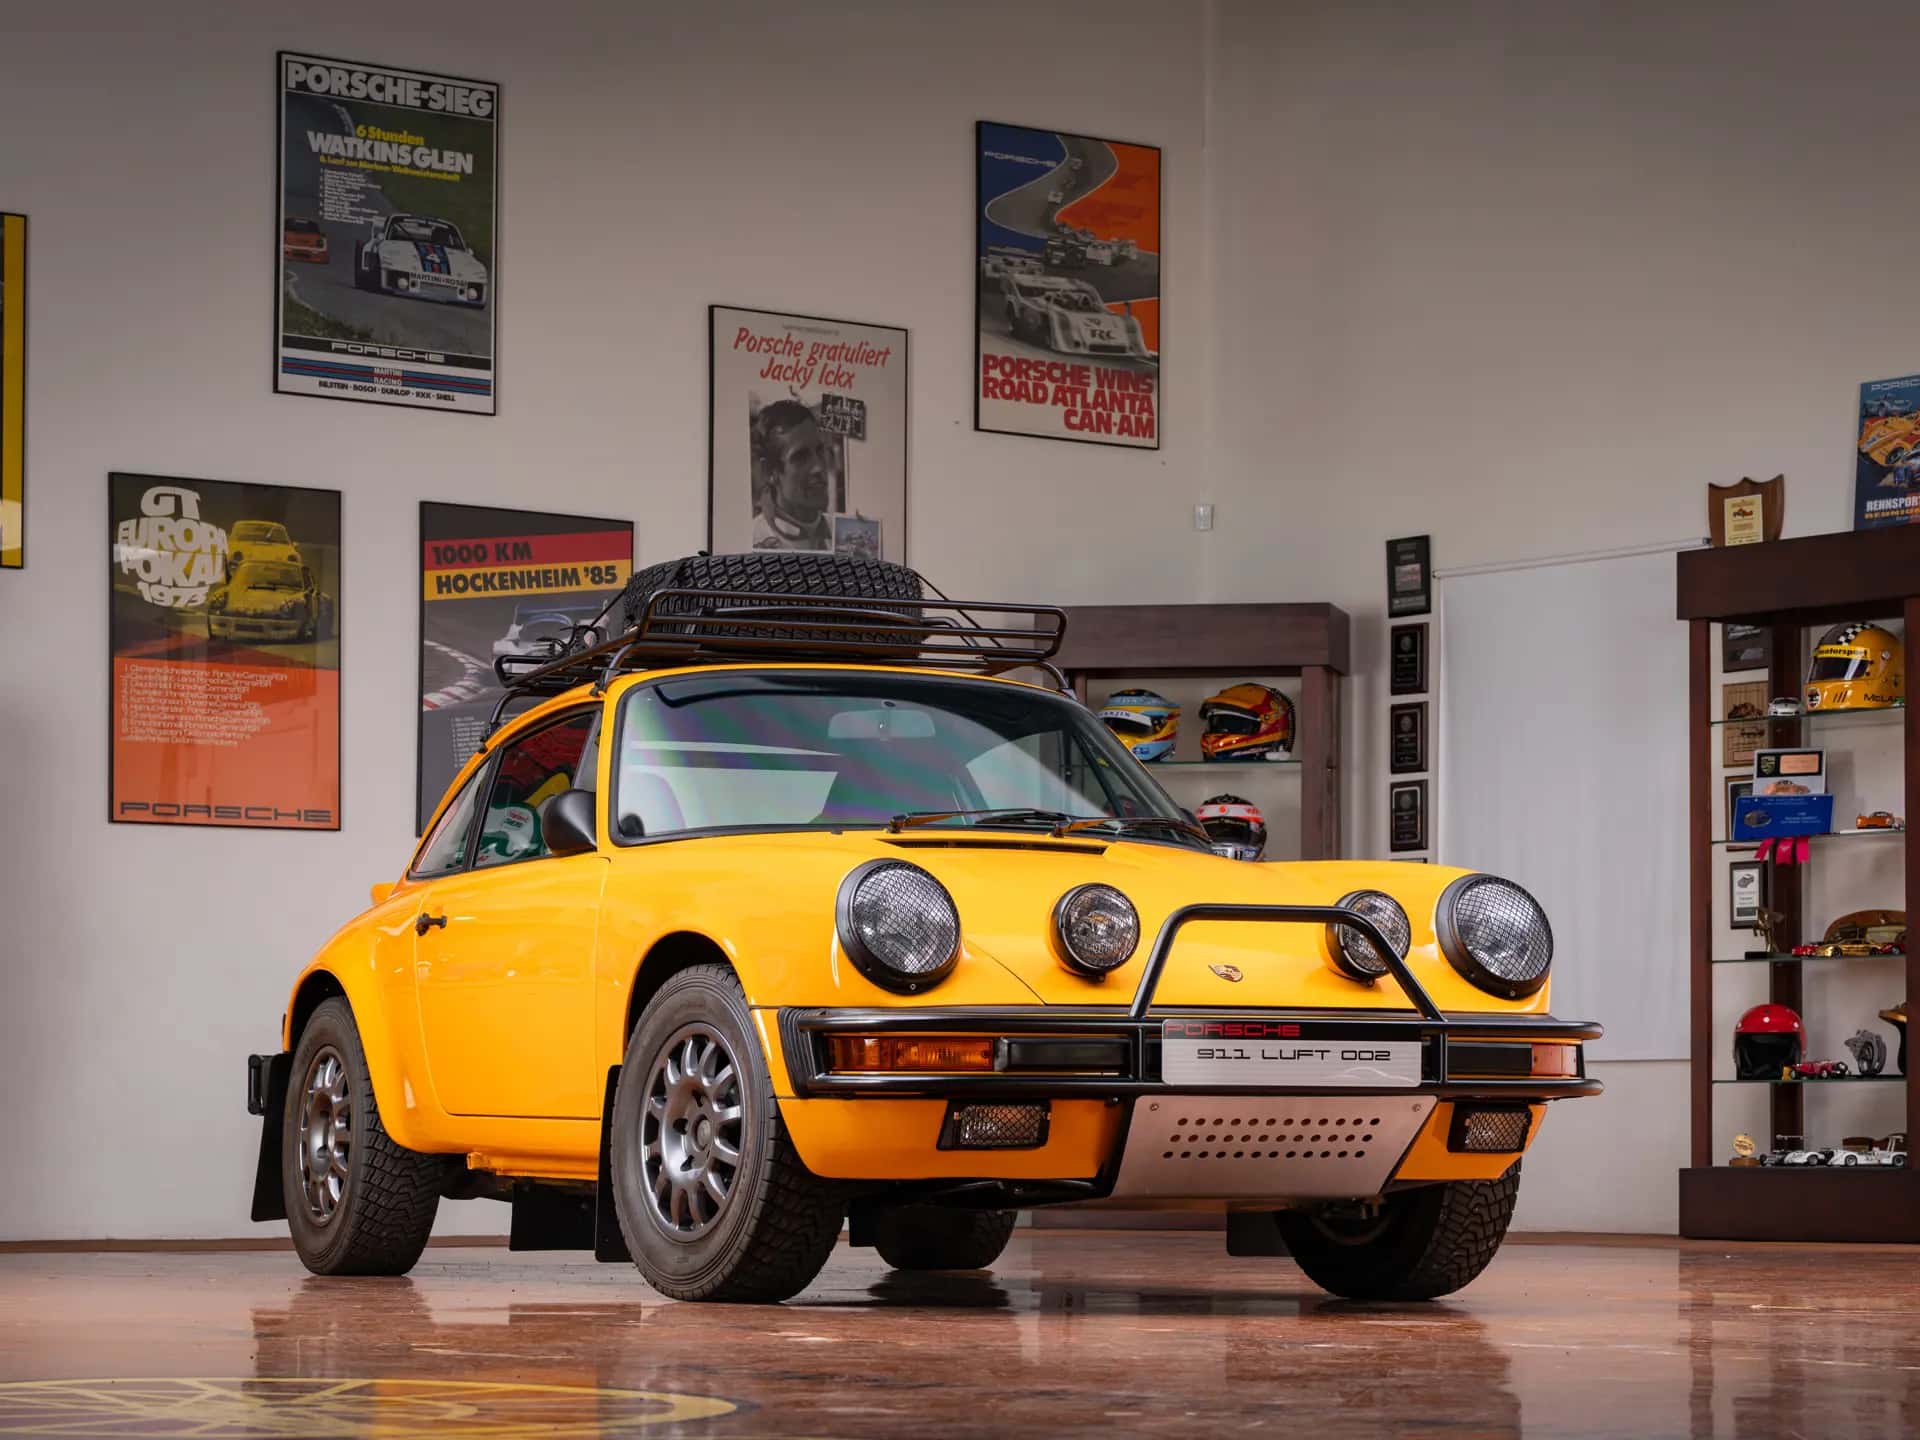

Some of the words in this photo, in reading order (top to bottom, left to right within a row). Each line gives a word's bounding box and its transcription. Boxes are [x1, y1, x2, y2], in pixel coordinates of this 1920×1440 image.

[287, 62, 492, 116] PORSCHE-SIEG
[356, 125, 366, 137] 6
[368, 126, 424, 145] Stunden
[307, 131, 411, 165] WATKINS
[413, 147, 472, 174] GLEN
[331, 342, 445, 362] PORSCHE
[733, 327, 804, 358] Porsche
[805, 341, 891, 367] gratuliert
[759, 357, 814, 390] Jacky
[818, 363, 855, 389] Ickx
[982, 353, 1091, 388] PORSCHE
[1095, 367, 1153, 394] WINS
[318, 380, 349, 391] BILSTEIN
[353, 384, 377, 393] BOSCH
[381, 387, 411, 397] DUNLOP
[436, 392, 456, 402] SHELL
[982, 376, 1048, 404] ROAD
[1051, 385, 1154, 416] ATLANTA
[140, 486, 200, 521] GT
[118, 517, 229, 554] EUROPA
[119, 550, 226, 588] POKAL
[431, 545, 489, 565] 1000
[495, 542, 533, 561] KM
[137, 581, 210, 608] 1973
[436, 567, 581, 594] HOCKENHEIM
[584, 565, 618, 585] '85
[120, 802, 332, 823] PORSCHE
[1165, 1023, 1301, 1037] PORSCHE
[1197, 1048, 1251, 1060] 911
[1261, 1049, 1331, 1061] LUFT
[1341, 1050, 1391, 1061] 002
